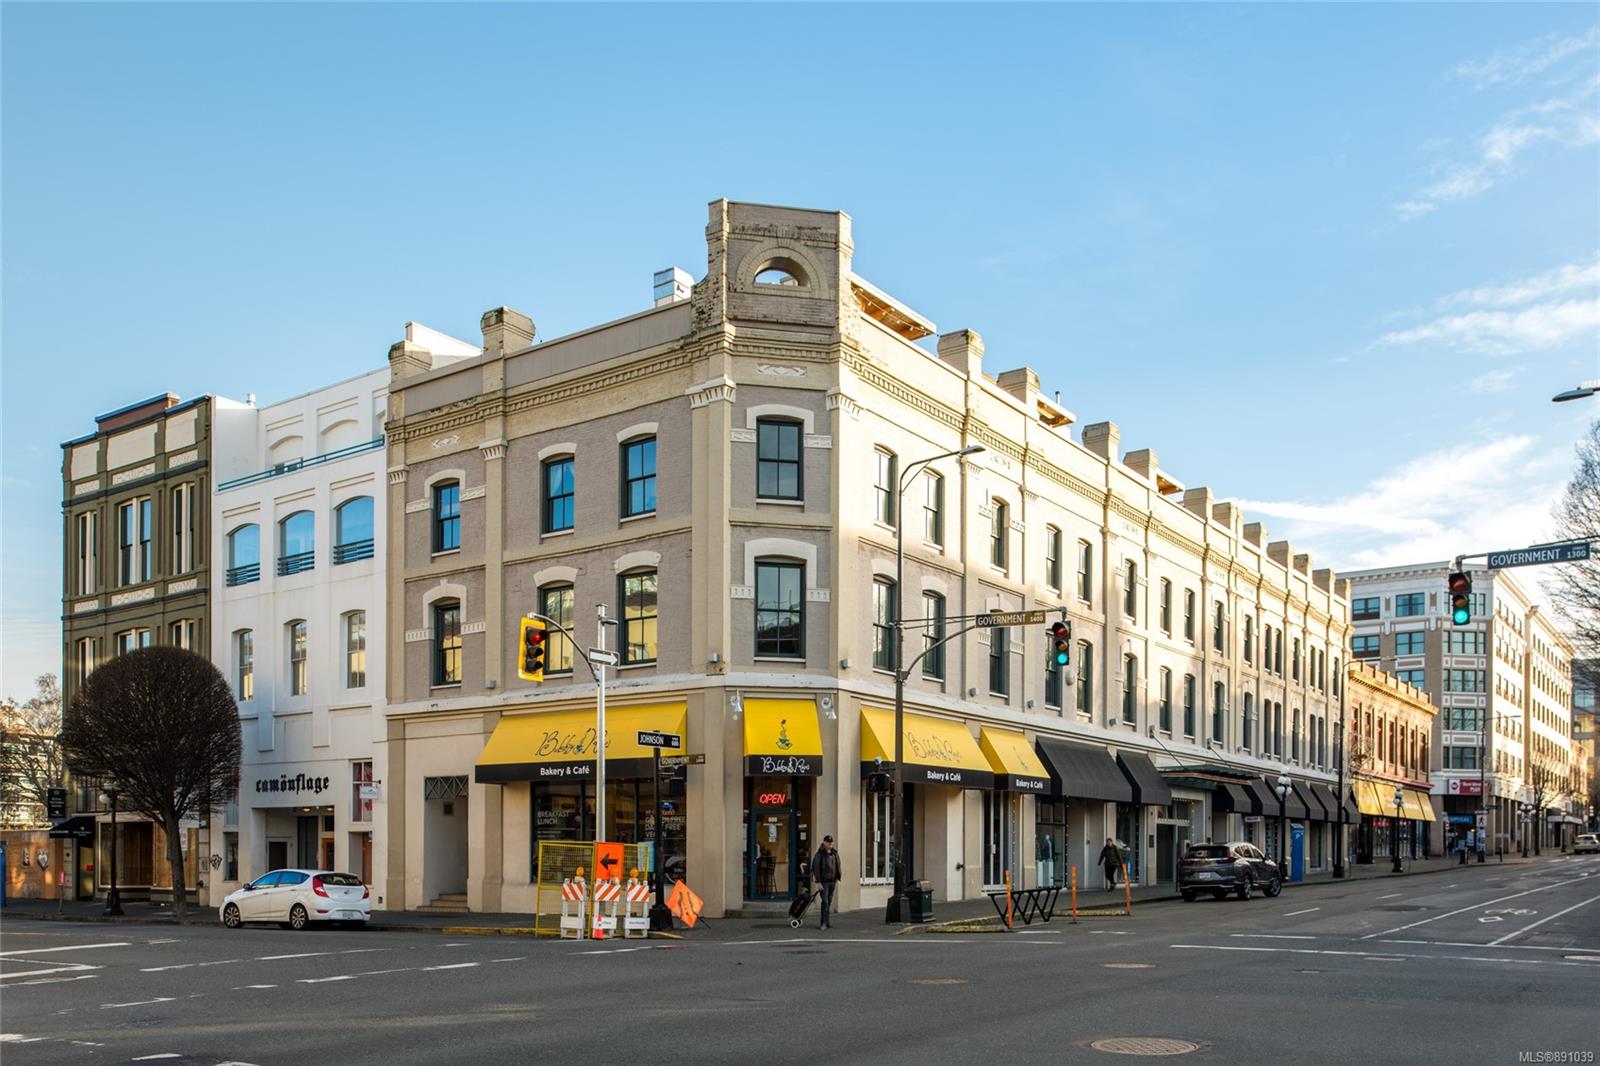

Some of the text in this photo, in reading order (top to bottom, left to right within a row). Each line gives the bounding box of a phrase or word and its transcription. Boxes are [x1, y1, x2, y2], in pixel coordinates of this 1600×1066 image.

[1490, 549, 1586, 566] GOVERNMENT 1300
[977, 614, 1025, 626] GOVERNMENT
[640, 734, 664, 745] JOHNSON
[540, 765, 590, 777] Bakery & Café
[927, 770, 961, 782] Bakery & Café
[256, 772, 329, 795] camönflage
[1015, 779, 1043, 789] Bakery & Café
[760, 793, 786, 804] OPEN
[537, 810, 570, 818] BREAKFAST
[665, 823, 681, 831] FREE
